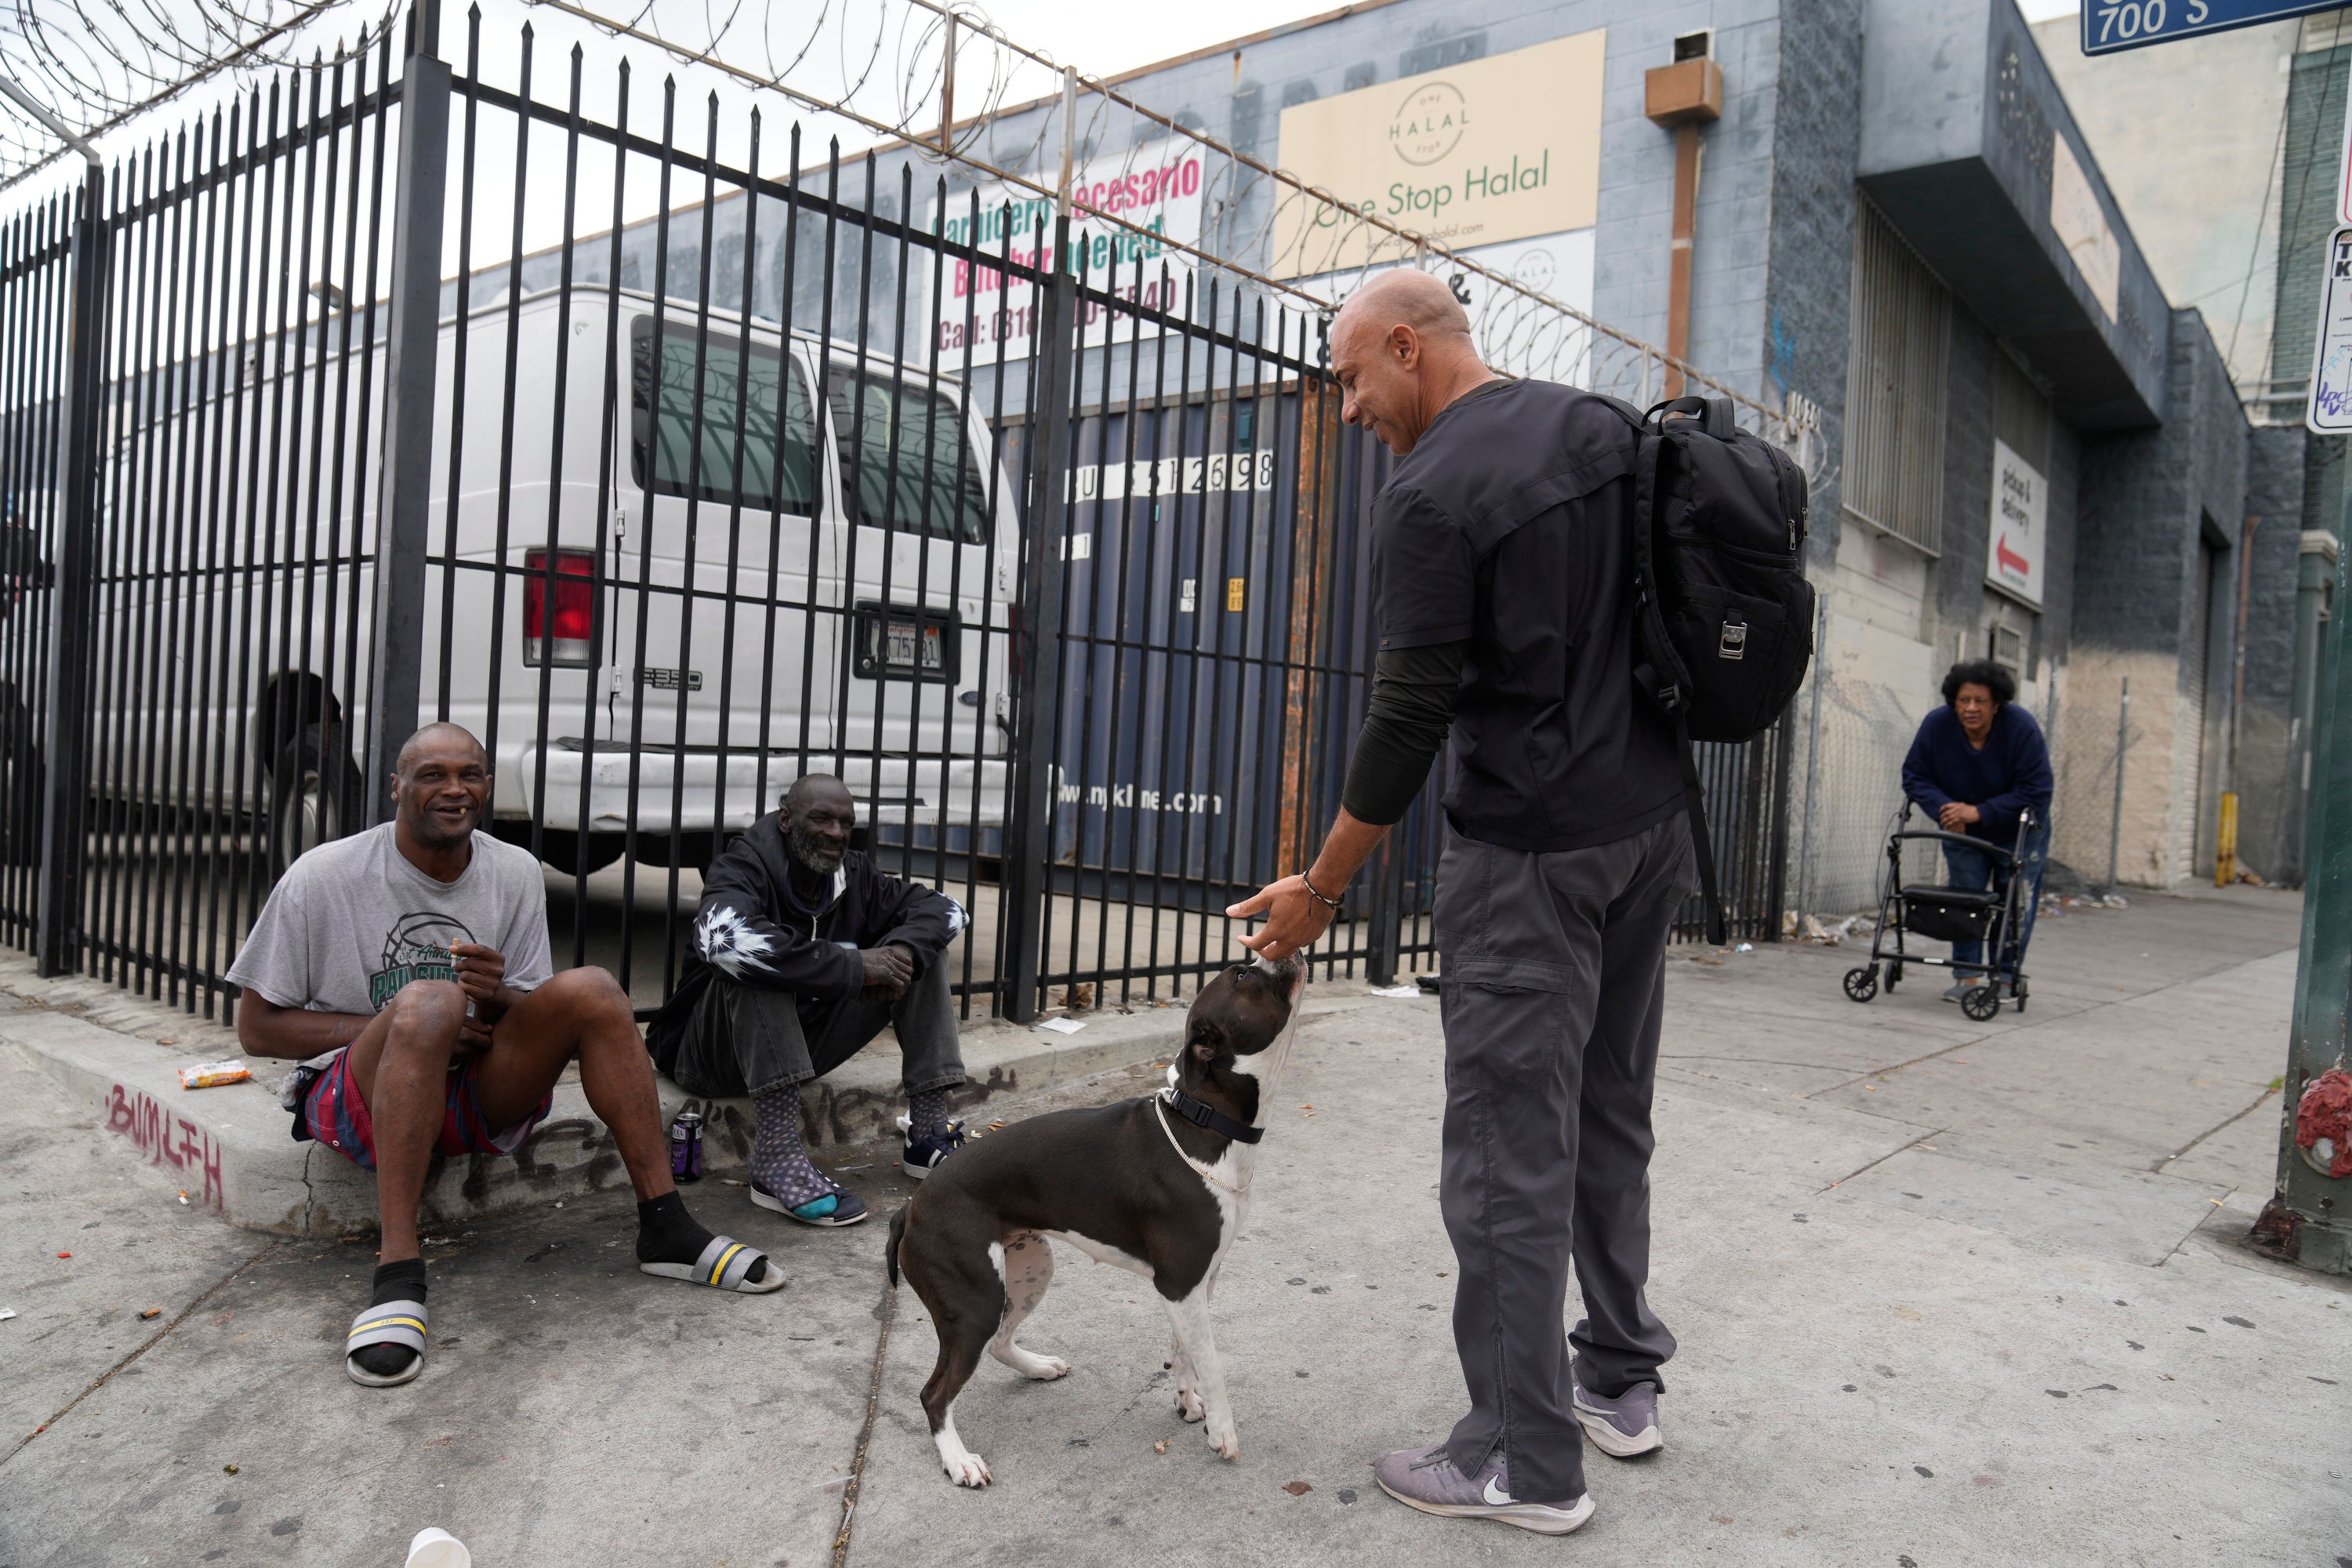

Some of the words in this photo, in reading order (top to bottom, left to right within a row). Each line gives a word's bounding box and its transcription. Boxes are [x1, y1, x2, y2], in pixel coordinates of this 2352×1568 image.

[2098, 0, 2166, 42] 700
[1389, 109, 1470, 140] HALAL
[1316, 197, 1376, 228] One
[1388, 183, 1452, 218] Stop
[1465, 148, 1548, 201] Halal
